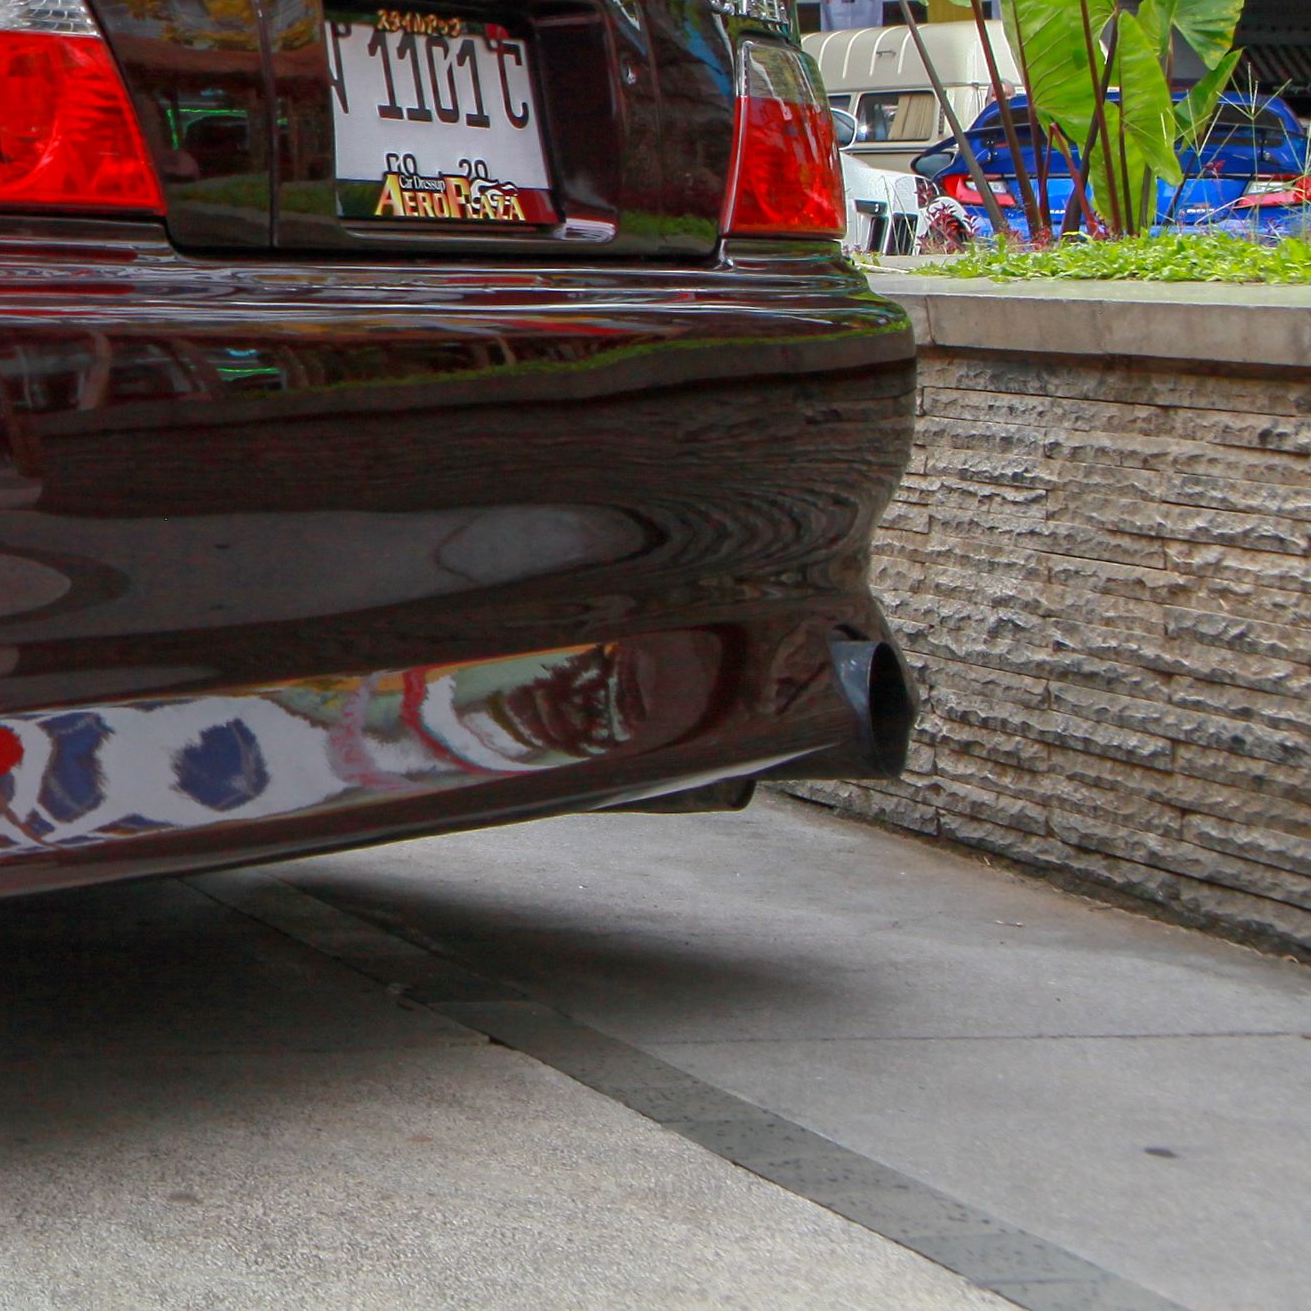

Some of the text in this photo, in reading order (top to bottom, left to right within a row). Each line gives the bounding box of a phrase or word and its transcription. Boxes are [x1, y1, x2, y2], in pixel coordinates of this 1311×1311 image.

[368, 31, 491, 129] 1101
[492, 42, 530, 129] C
[398, 175, 446, 193] Car Dressup
